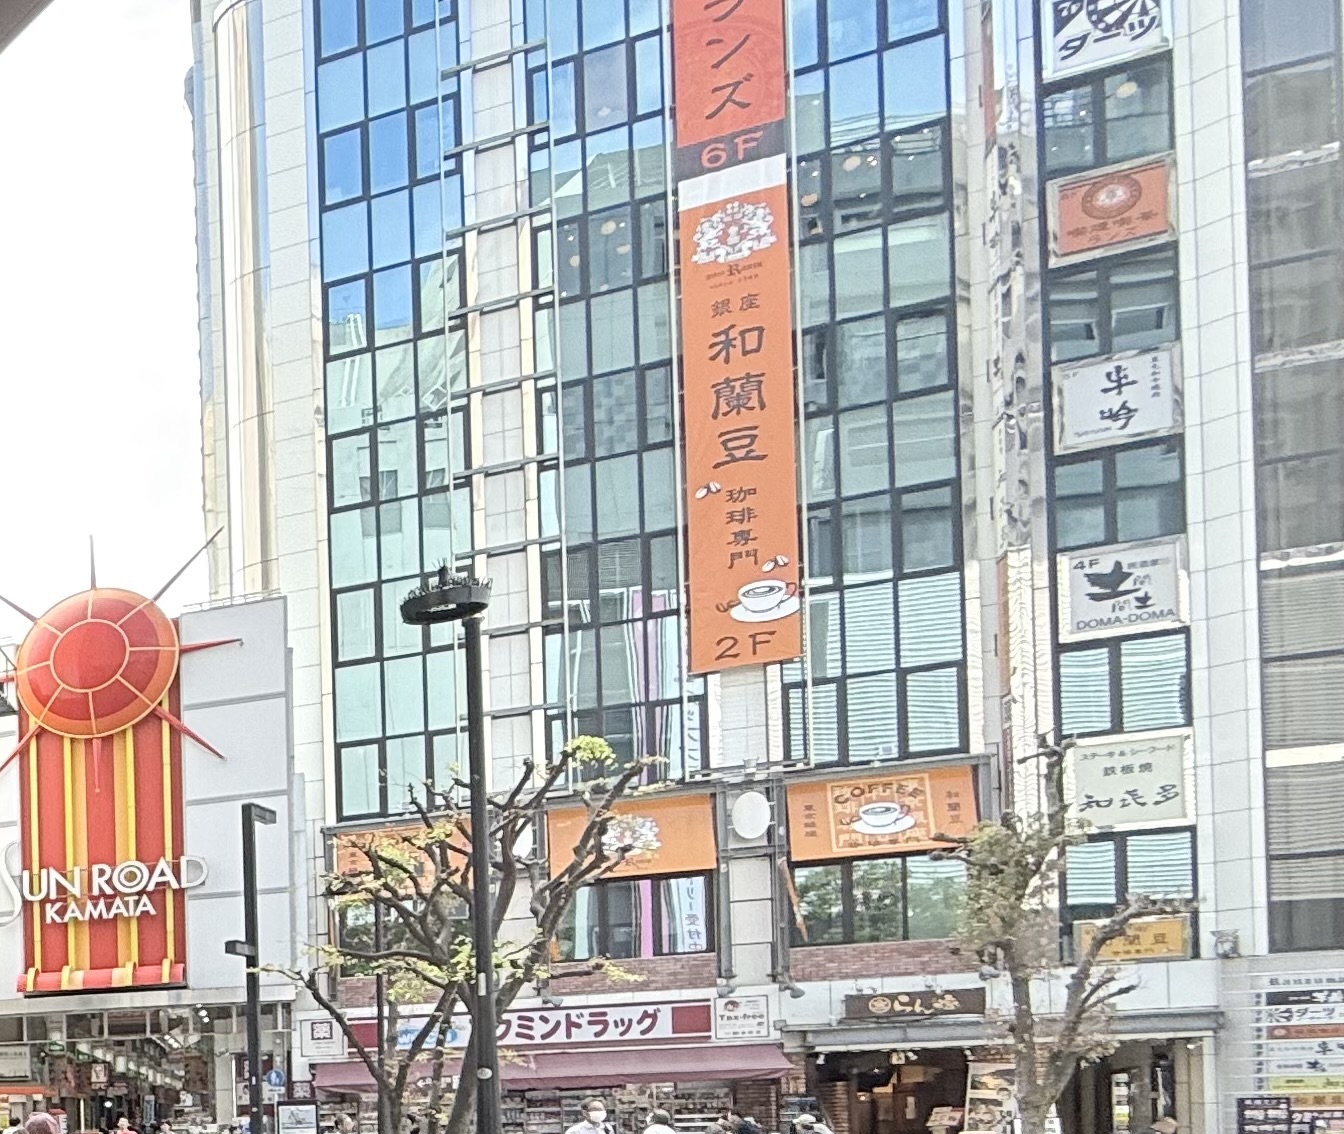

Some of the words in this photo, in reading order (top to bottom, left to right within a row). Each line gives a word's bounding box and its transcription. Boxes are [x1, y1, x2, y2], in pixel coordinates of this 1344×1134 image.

[1058, 14, 1158, 61] ダーツ
[701, 131, 763, 168] 6F
[708, 323, 769, 470] 和蘭豆
[725, 486, 759, 570] 珈琲専門
[1073, 558, 1099, 570] 4F
[1076, 608, 1176, 631] DOMA-DOMA
[715, 630, 777, 661] 2F
[834, 783, 924, 804] COFFEE
[0, 840, 81, 927] SUN
[91, 855, 209, 894] ROAD
[44, 894, 157, 924] KAMATA
[719, 1013, 764, 1021] Tax-free
